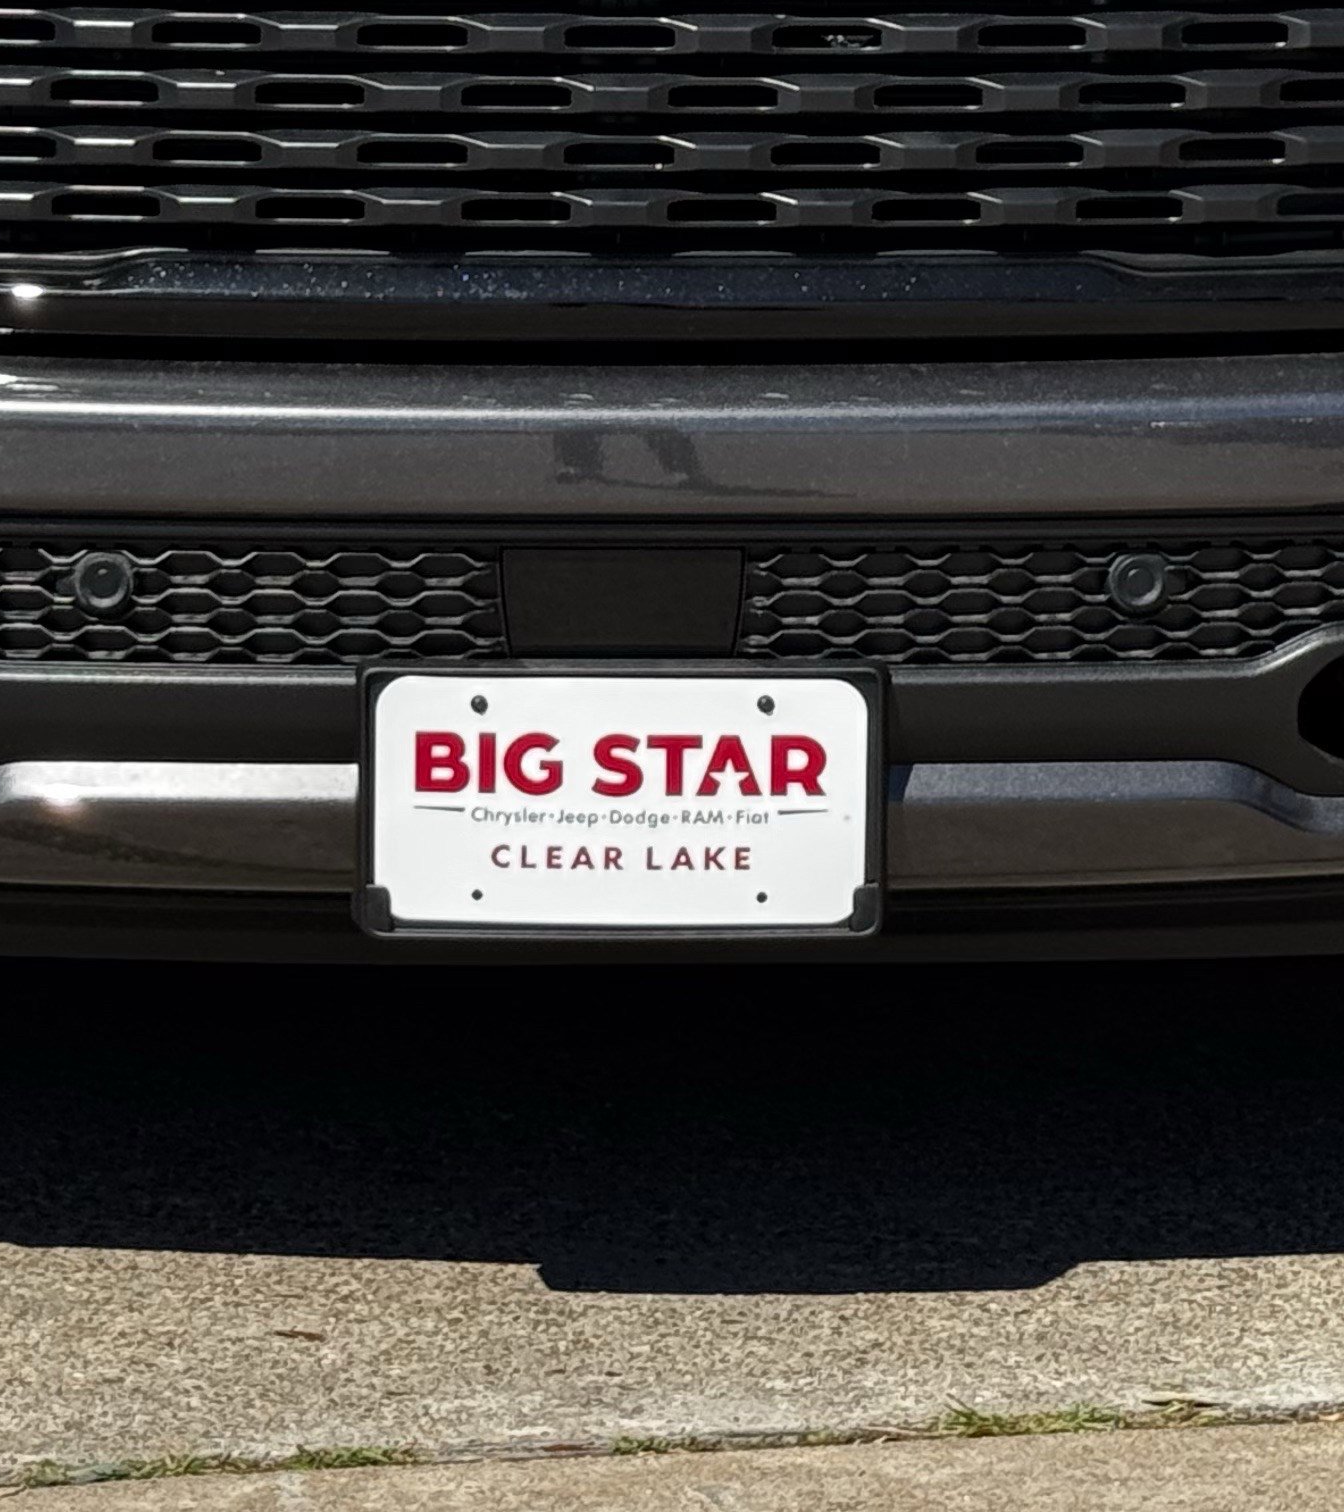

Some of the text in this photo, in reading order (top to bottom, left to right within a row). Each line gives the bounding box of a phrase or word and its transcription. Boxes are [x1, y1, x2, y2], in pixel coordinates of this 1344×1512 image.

[414, 730, 828, 797] BIG STAR
[470, 806, 770, 829] Chrysler Jeep Dodge RAM Fiat
[491, 844, 752, 871] CLEAR LAKE
